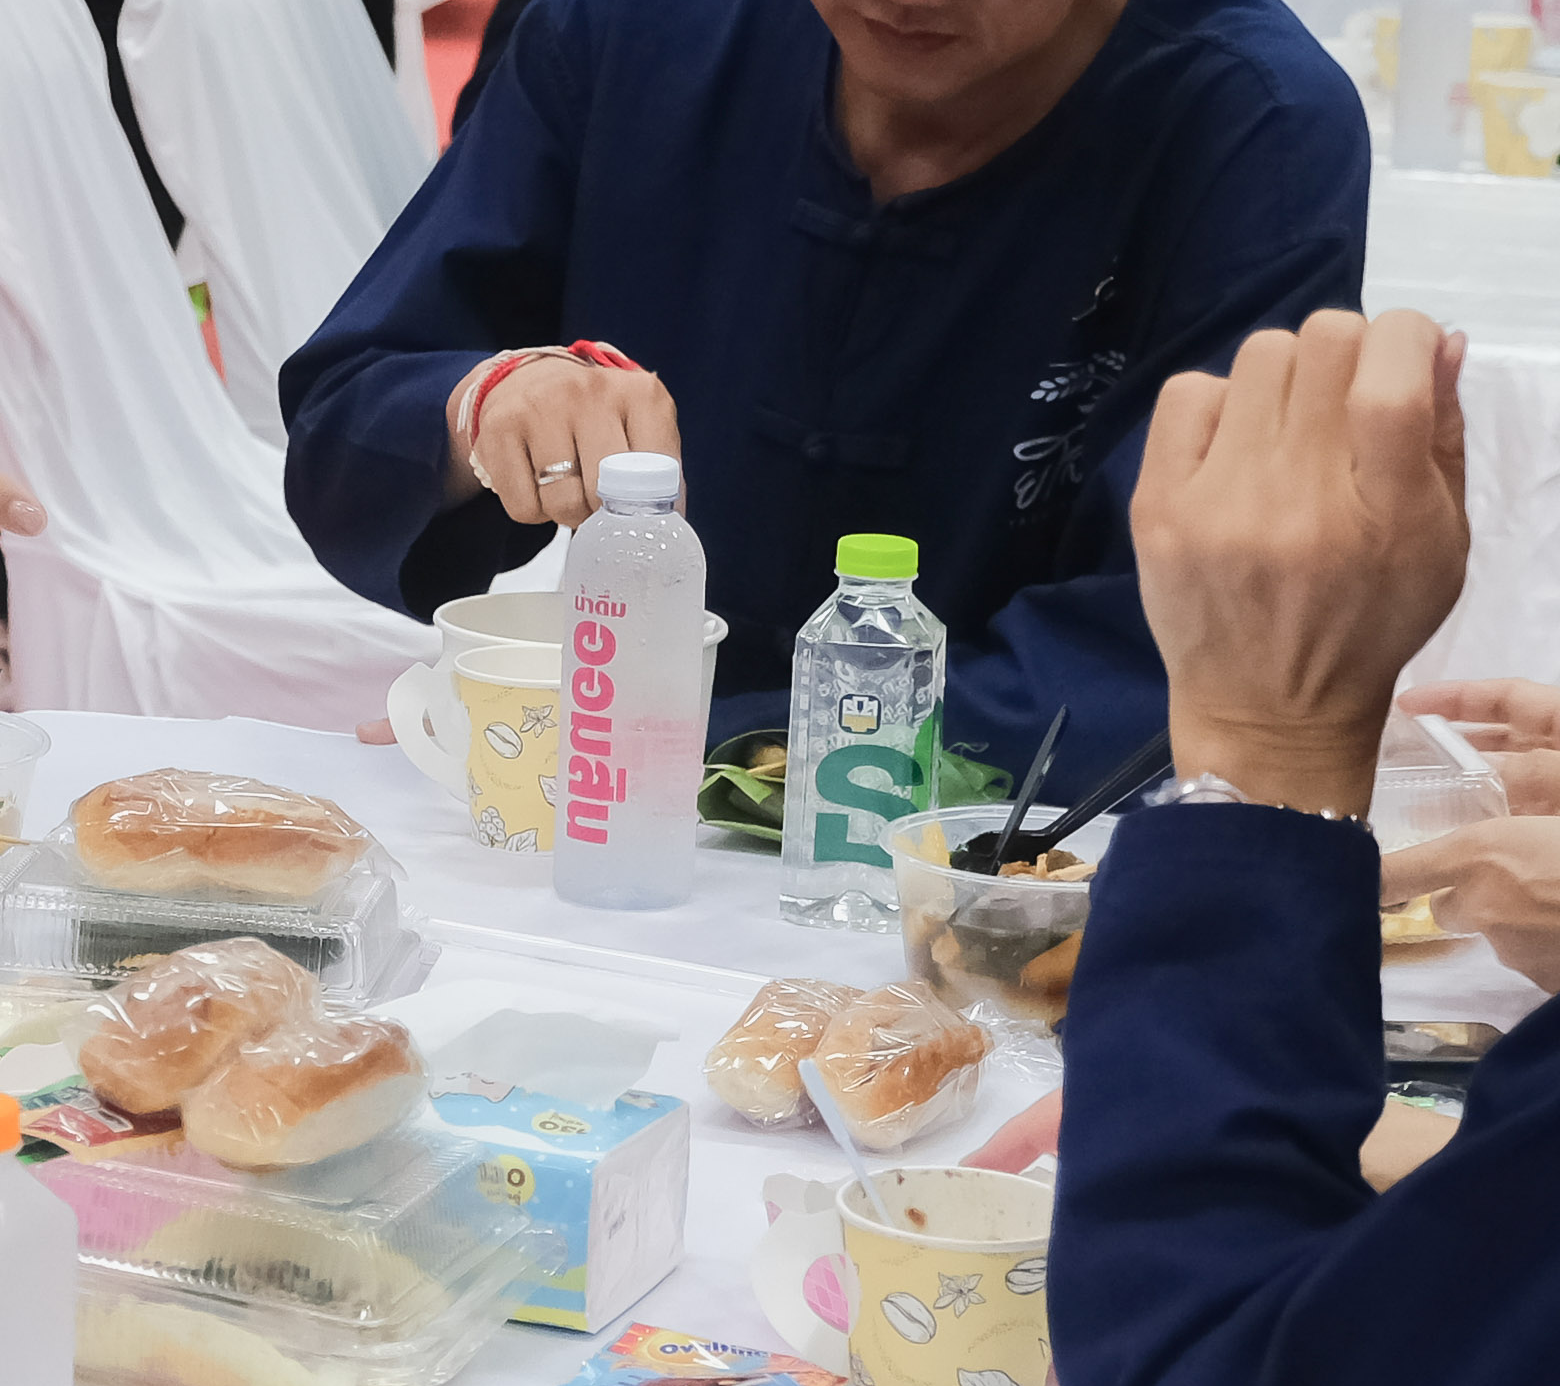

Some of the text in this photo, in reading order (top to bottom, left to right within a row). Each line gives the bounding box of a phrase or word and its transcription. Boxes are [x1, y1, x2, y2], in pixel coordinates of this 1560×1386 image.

[574, 583, 627, 618] น้ำดื่ม
[566, 620, 627, 845] ออมสิน
